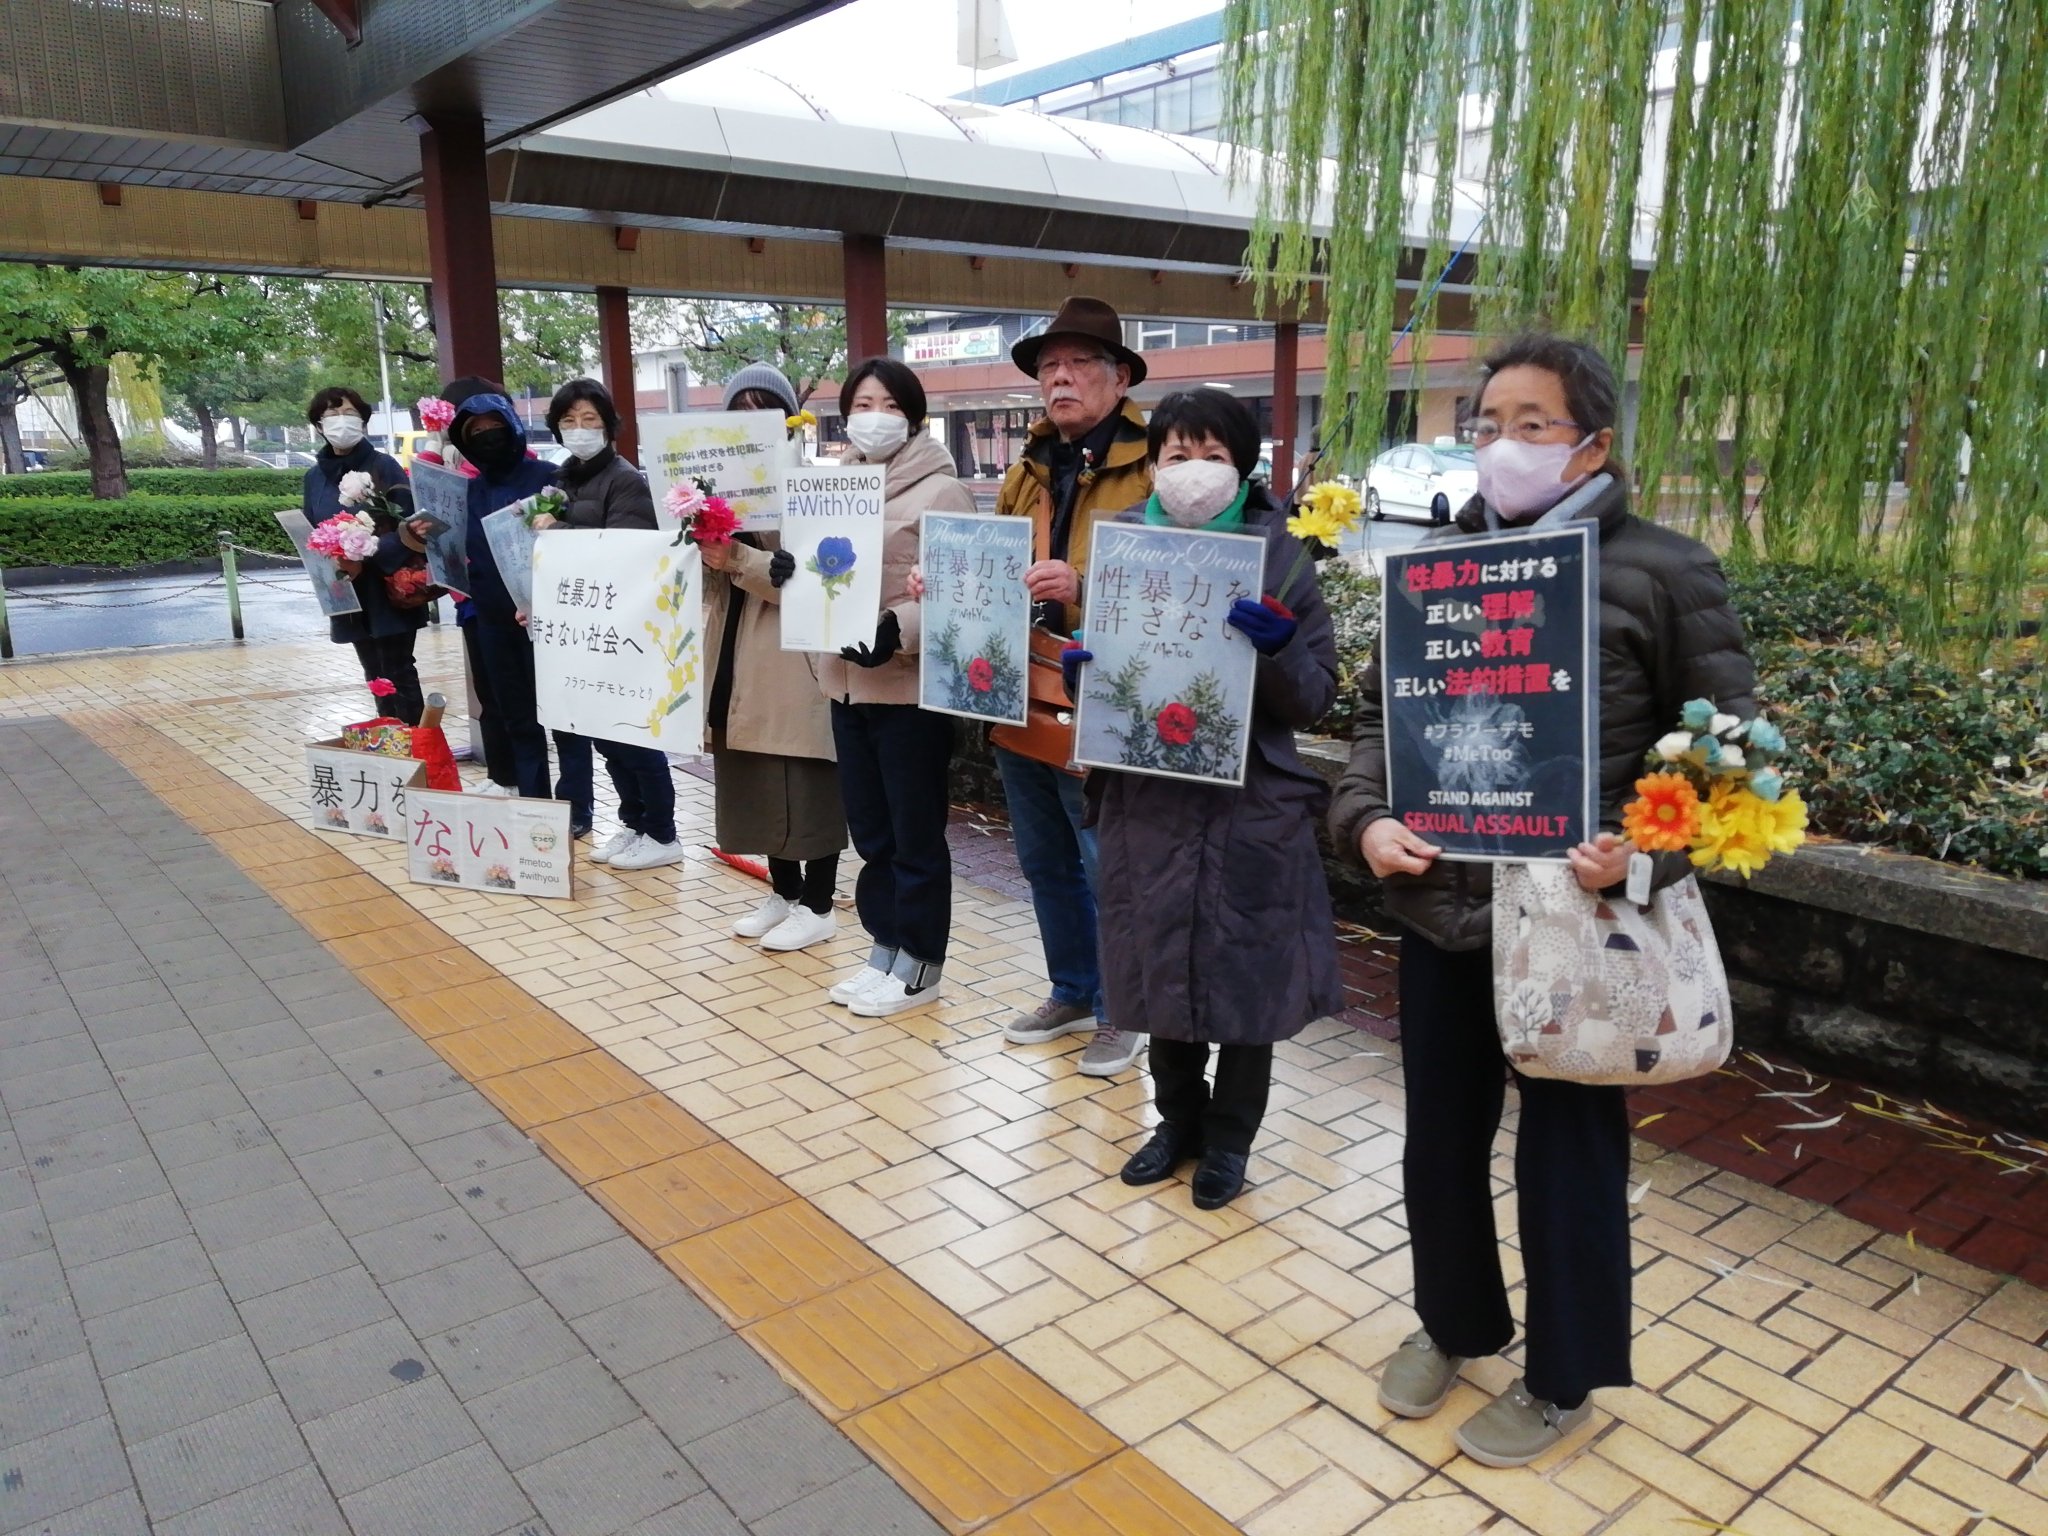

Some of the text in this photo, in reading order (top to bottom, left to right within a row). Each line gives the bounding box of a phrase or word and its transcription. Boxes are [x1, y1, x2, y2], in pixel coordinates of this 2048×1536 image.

[787, 476, 880, 492] FLOWERDEMO
[787, 493, 880, 516] #WithYou
[925, 519, 1027, 547] Flower Demo
[926, 546, 1022, 581] 性暴力を
[1097, 530, 1258, 572] Flower Demo
[1098, 564, 1250, 608] 性暴力を
[1407, 556, 1558, 592] 性暴力に対する
[556, 577, 617, 610] 性暴力を
[925, 576, 1023, 606] 許さない
[1425, 590, 1536, 625] 正しい理解
[1138, 641, 1193, 659] #MeToo
[1425, 627, 1534, 660] 正しい教育
[564, 675, 653, 702] フラワーデモとっとり
[1394, 664, 1572, 698] 正しい法的措置を
[1424, 721, 1534, 740] #フラワーデモ
[1444, 745, 1514, 763] #MeToo
[1428, 790, 1534, 807] STAND AGAINST
[414, 808, 509, 858] ない
[1404, 811, 1569, 837] SEXUAL ASSAULT
[519, 856, 553, 868] #metoo
[519, 871, 560, 884] #withyou
